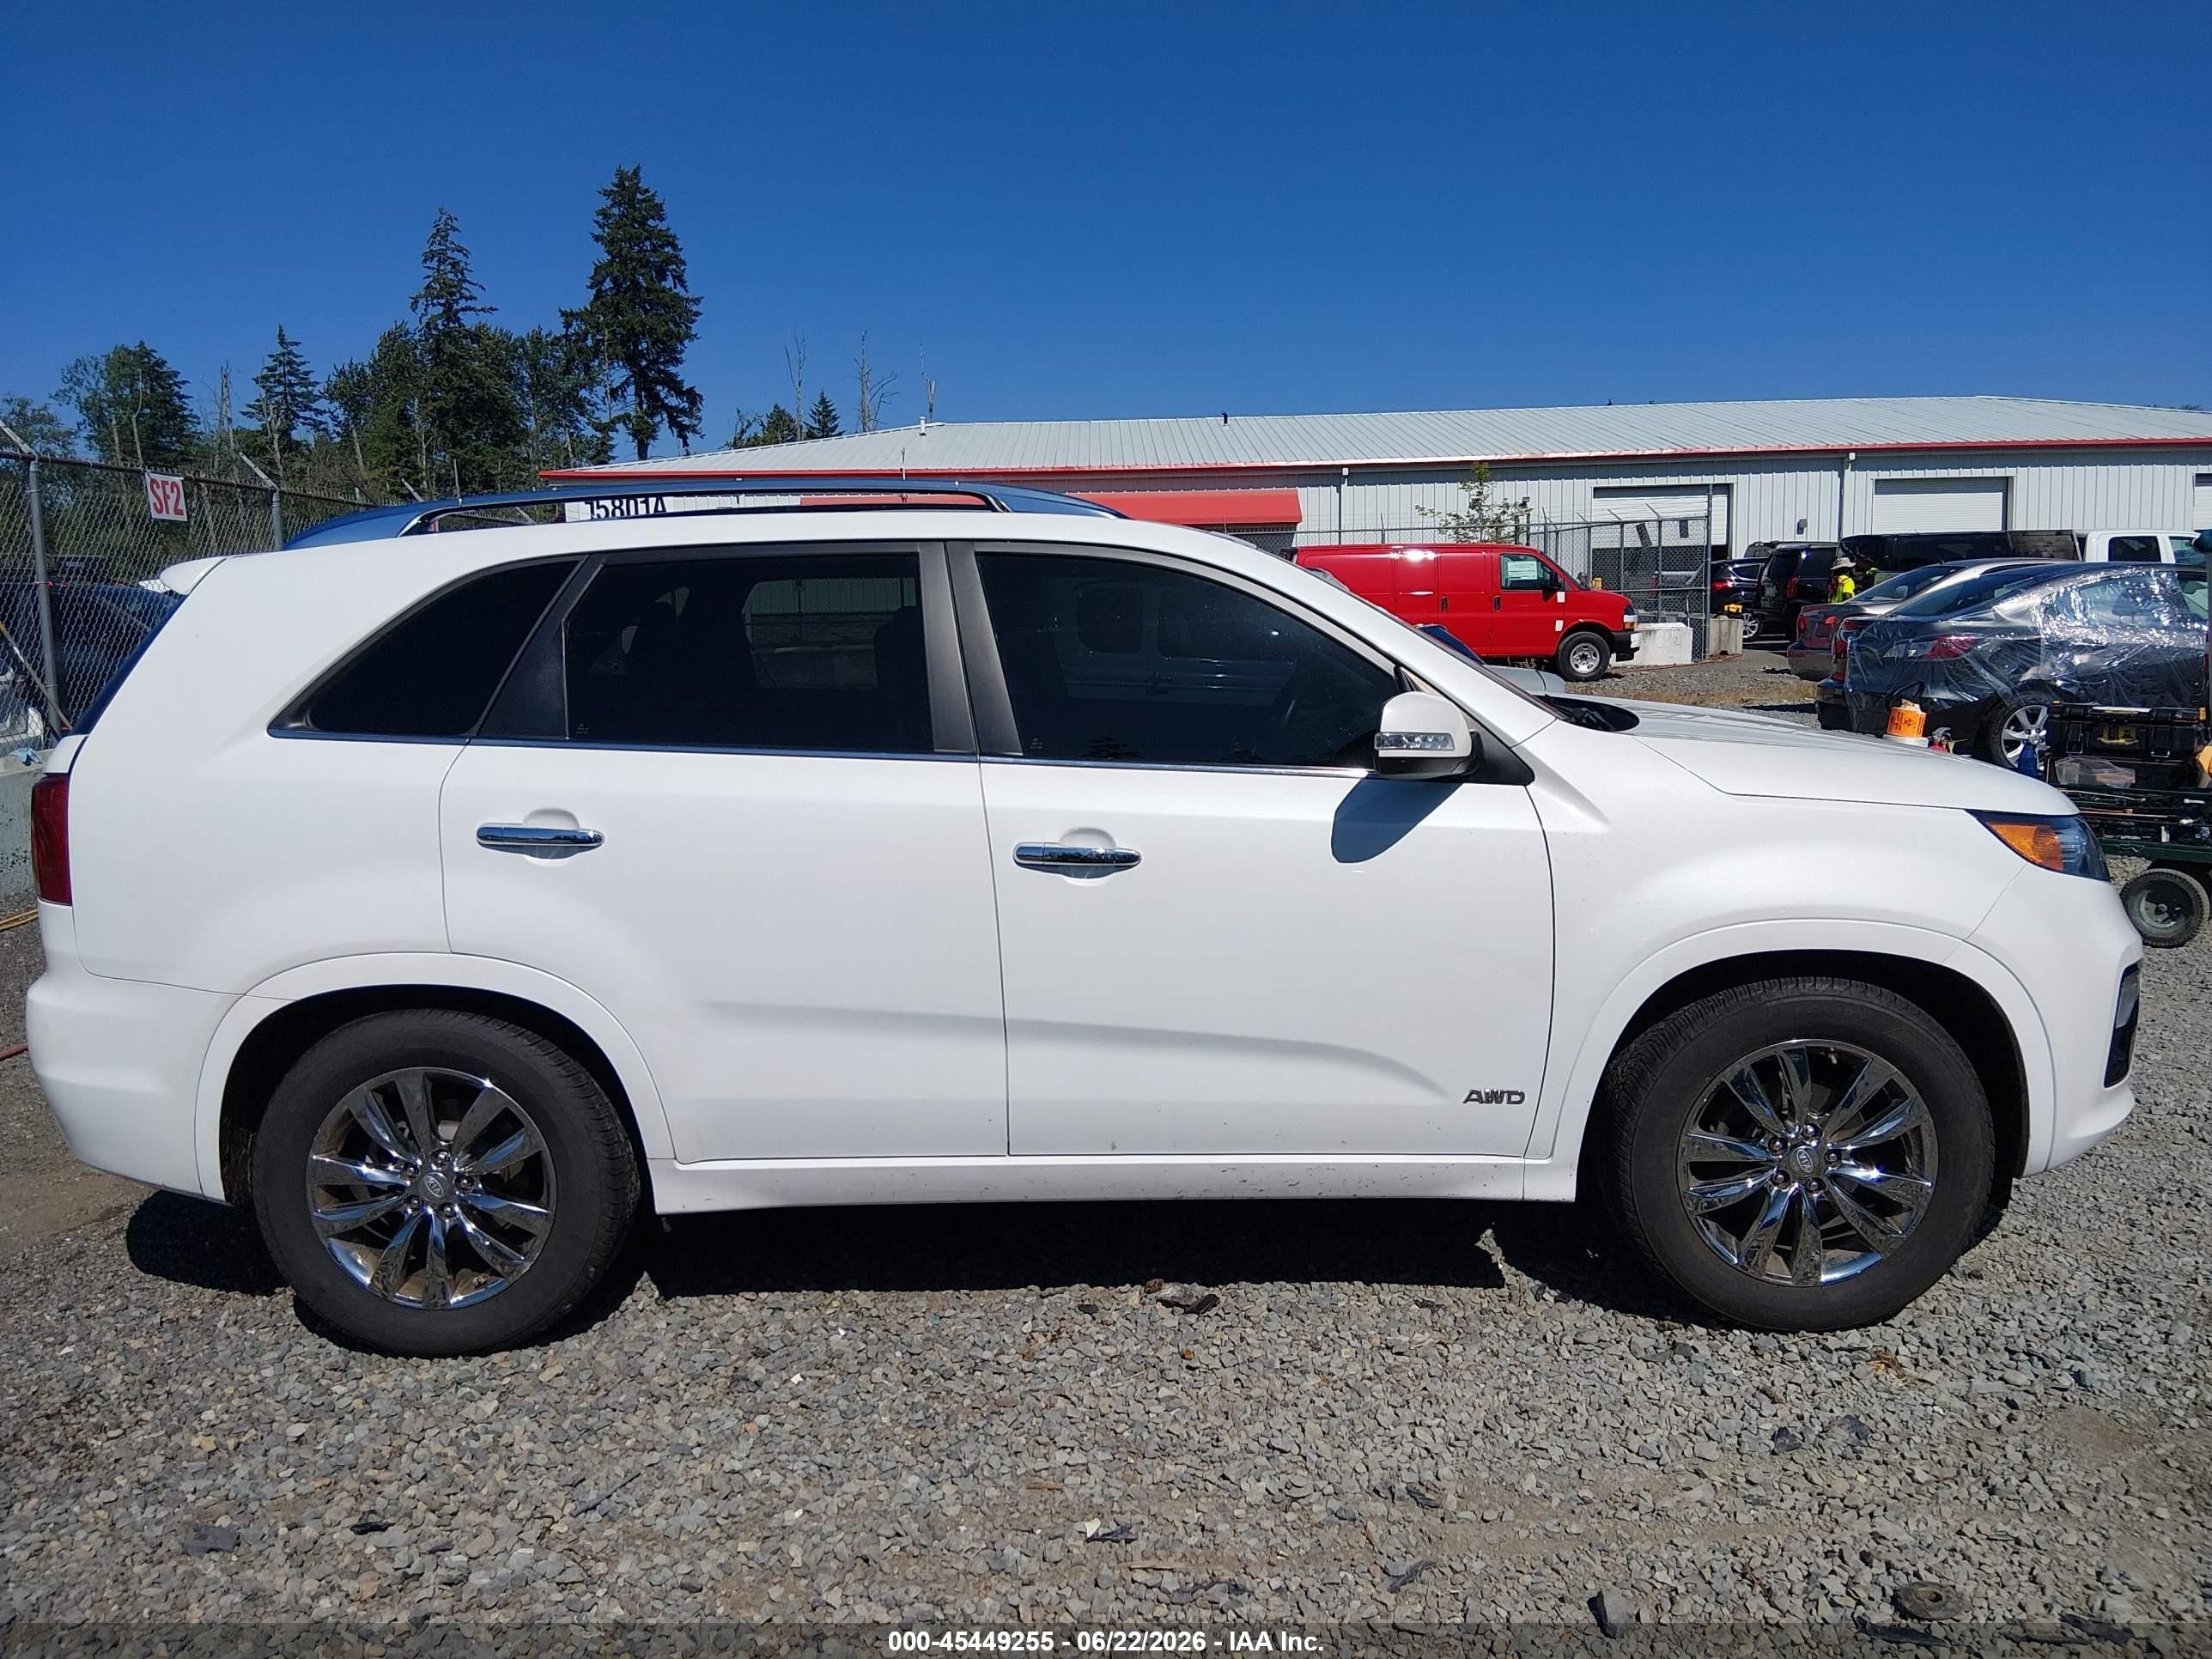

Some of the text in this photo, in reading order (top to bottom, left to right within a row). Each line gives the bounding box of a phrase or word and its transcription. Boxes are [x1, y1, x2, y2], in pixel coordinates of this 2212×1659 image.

[150, 478, 184, 516] SF2
[1462, 1089, 1526, 1105] AWD
[1799, 1152, 1812, 1170] KIA
[427, 1177, 441, 1194] KIA
